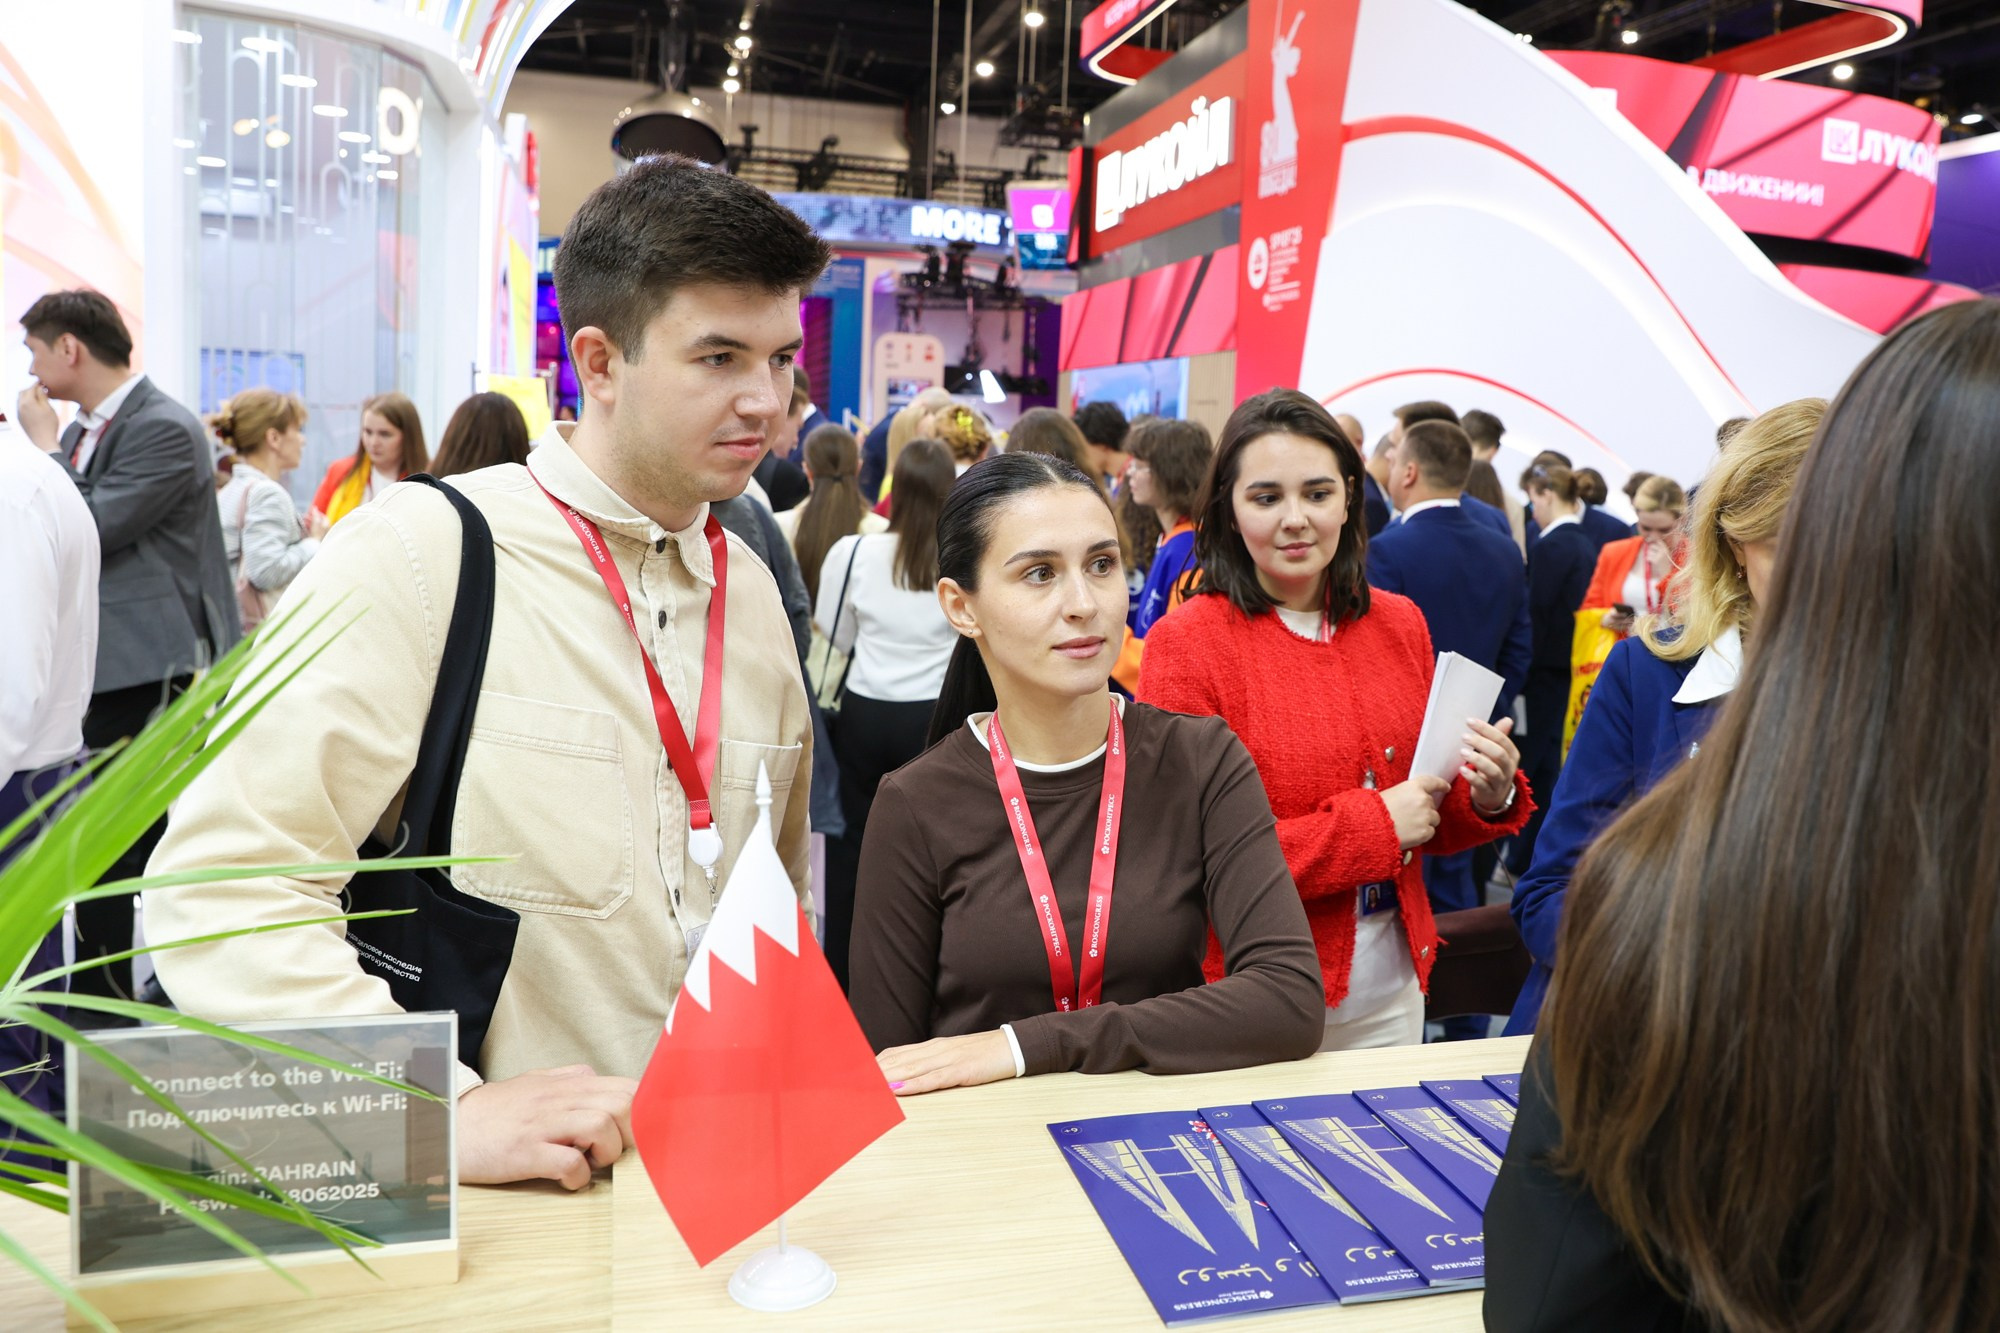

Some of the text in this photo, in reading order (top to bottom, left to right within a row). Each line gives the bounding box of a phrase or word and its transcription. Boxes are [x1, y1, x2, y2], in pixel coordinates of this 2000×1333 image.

[910, 204, 1001, 245] MORE
[573, 514, 606, 563] ROSCONGRESS
[1013, 804, 1034, 856] ROSCONGRESS
[1103, 794, 1115, 846] РОСКОНГРЕСС
[1043, 903, 1062, 957] РОСКОНГРЕСС
[1091, 895, 1103, 949] ROSCONGRESS
[374, 958, 421, 982] купечества
[382, 952, 423, 974] наследие
[249, 1068, 276, 1087] to
[282, 1065, 323, 1085] the
[322, 1100, 337, 1115] к
[342, 1093, 408, 1114] Wi-Fi:
[1178, 1263, 1272, 1285] روسيا
[1431, 1260, 1484, 1271] ONGRESS
[1345, 1272, 1419, 1287] OSCONGRESS
[1173, 1292, 1260, 1312] ROSCONGRESS
